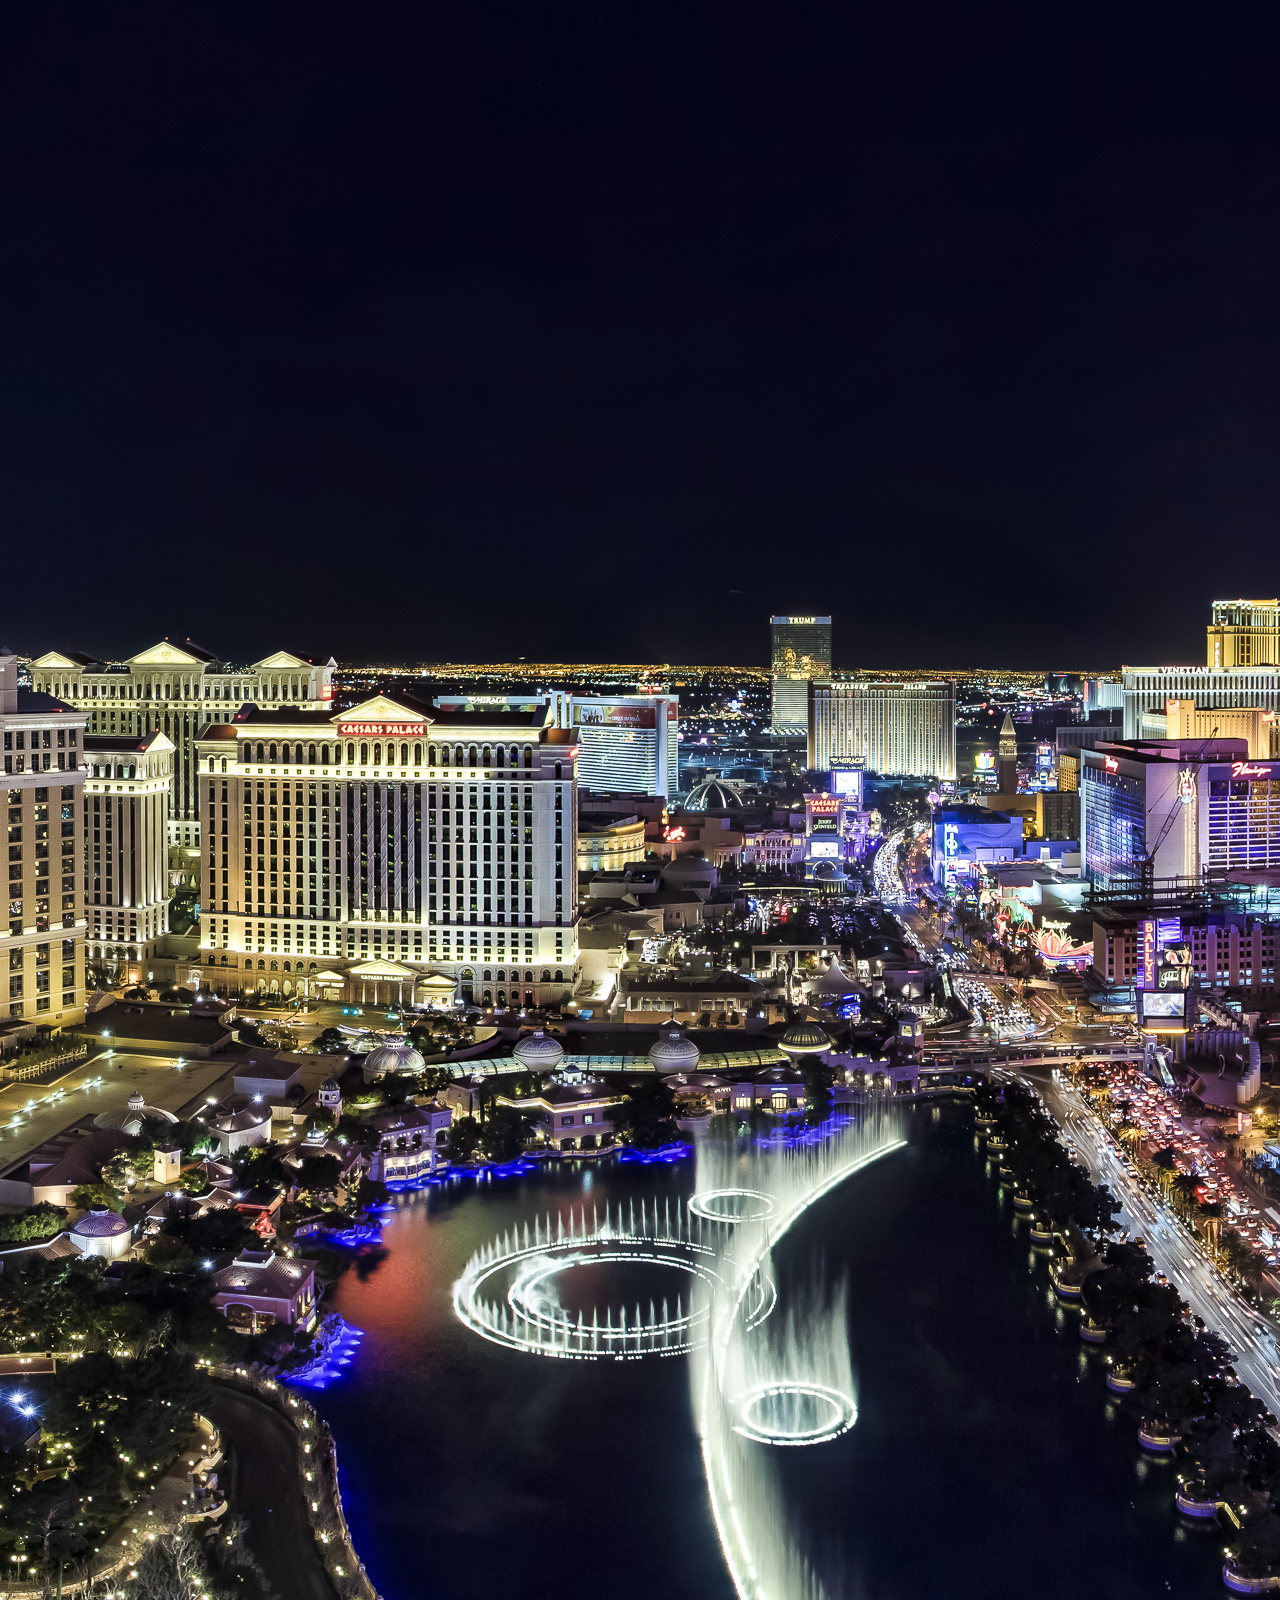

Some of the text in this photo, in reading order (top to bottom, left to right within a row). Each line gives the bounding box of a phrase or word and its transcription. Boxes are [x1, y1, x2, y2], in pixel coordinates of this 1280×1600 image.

[476, 696, 507, 704] MIRAGE
[341, 725, 424, 734] CAESARS PALACE
[1232, 762, 1271, 777] Flamingo
[1144, 922, 1153, 982] BALLYS
